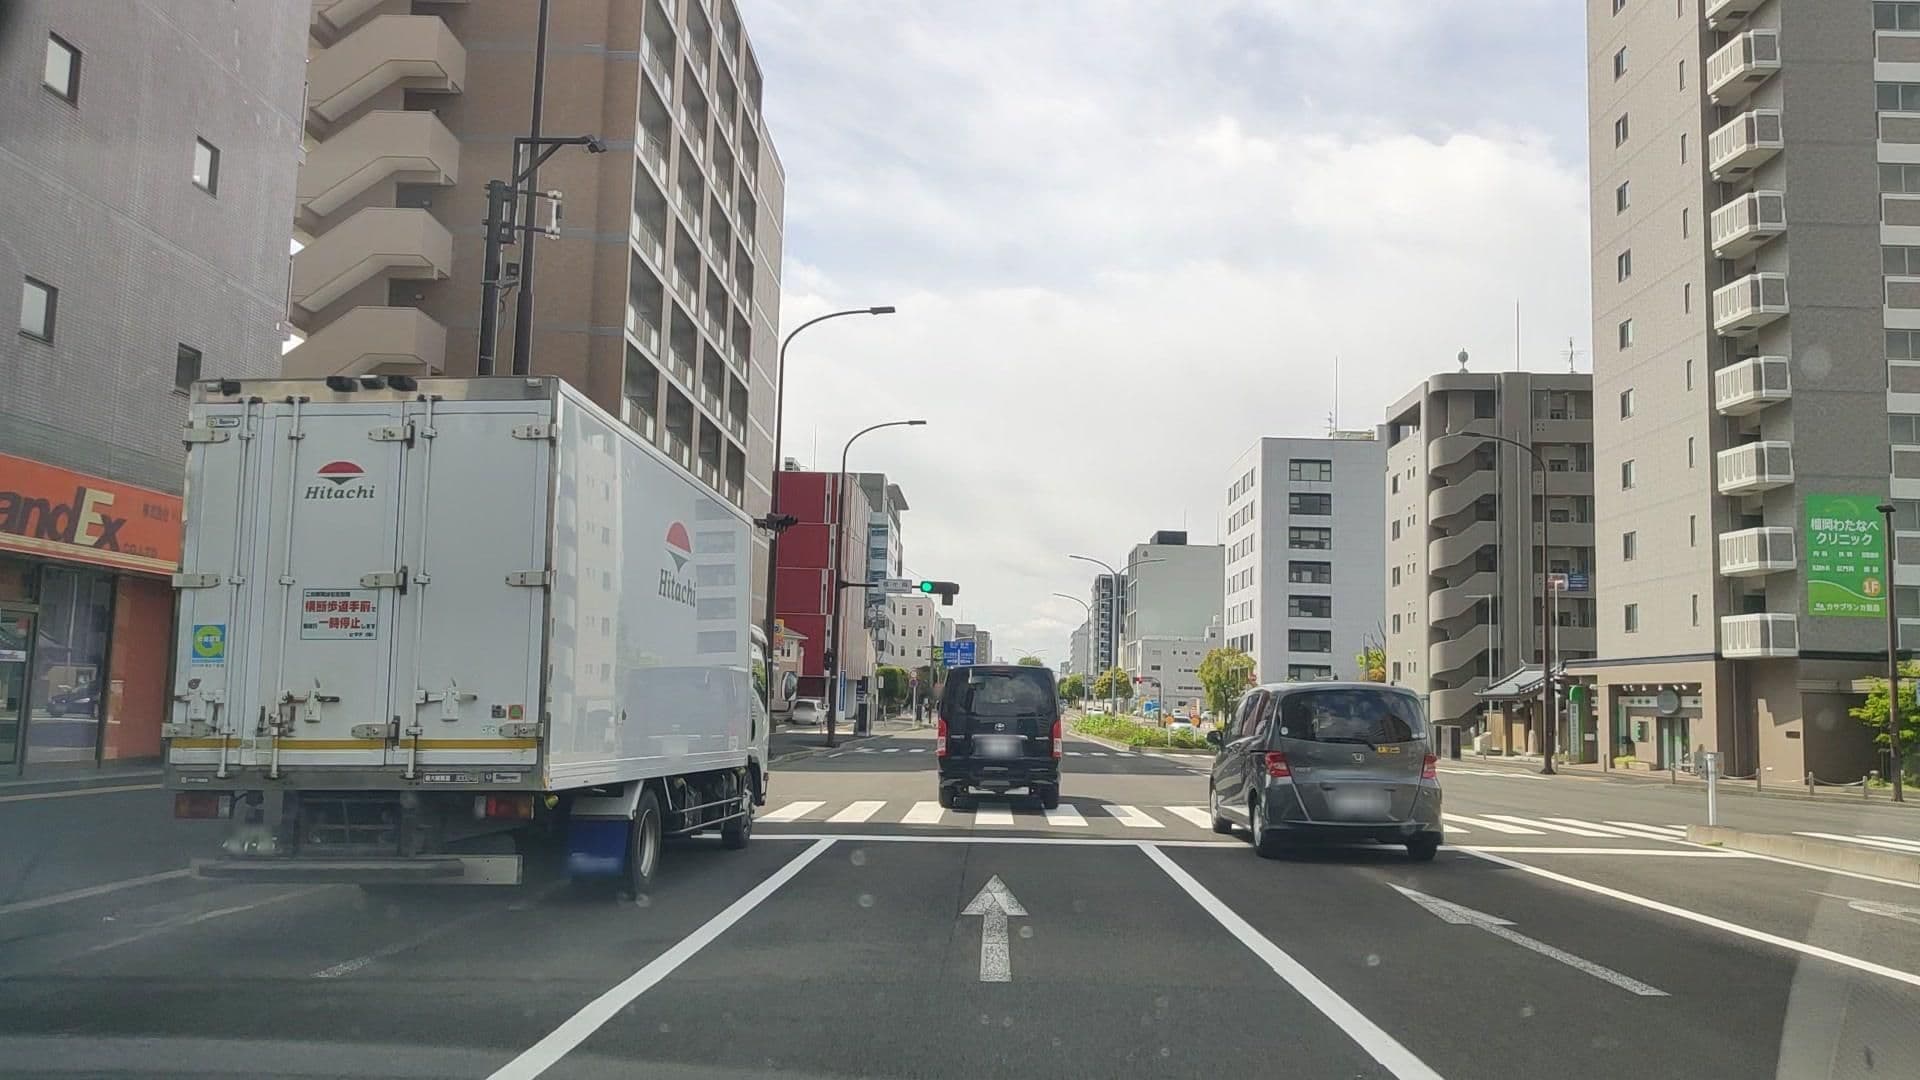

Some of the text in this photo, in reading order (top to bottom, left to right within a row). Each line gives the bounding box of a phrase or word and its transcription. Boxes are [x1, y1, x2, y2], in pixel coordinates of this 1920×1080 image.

[304, 485, 376, 500] Hitachi
[1816, 533, 1873, 546] クリニック
[658, 568, 697, 608] Hitachi
[1863, 580, 1880, 594] 1F
